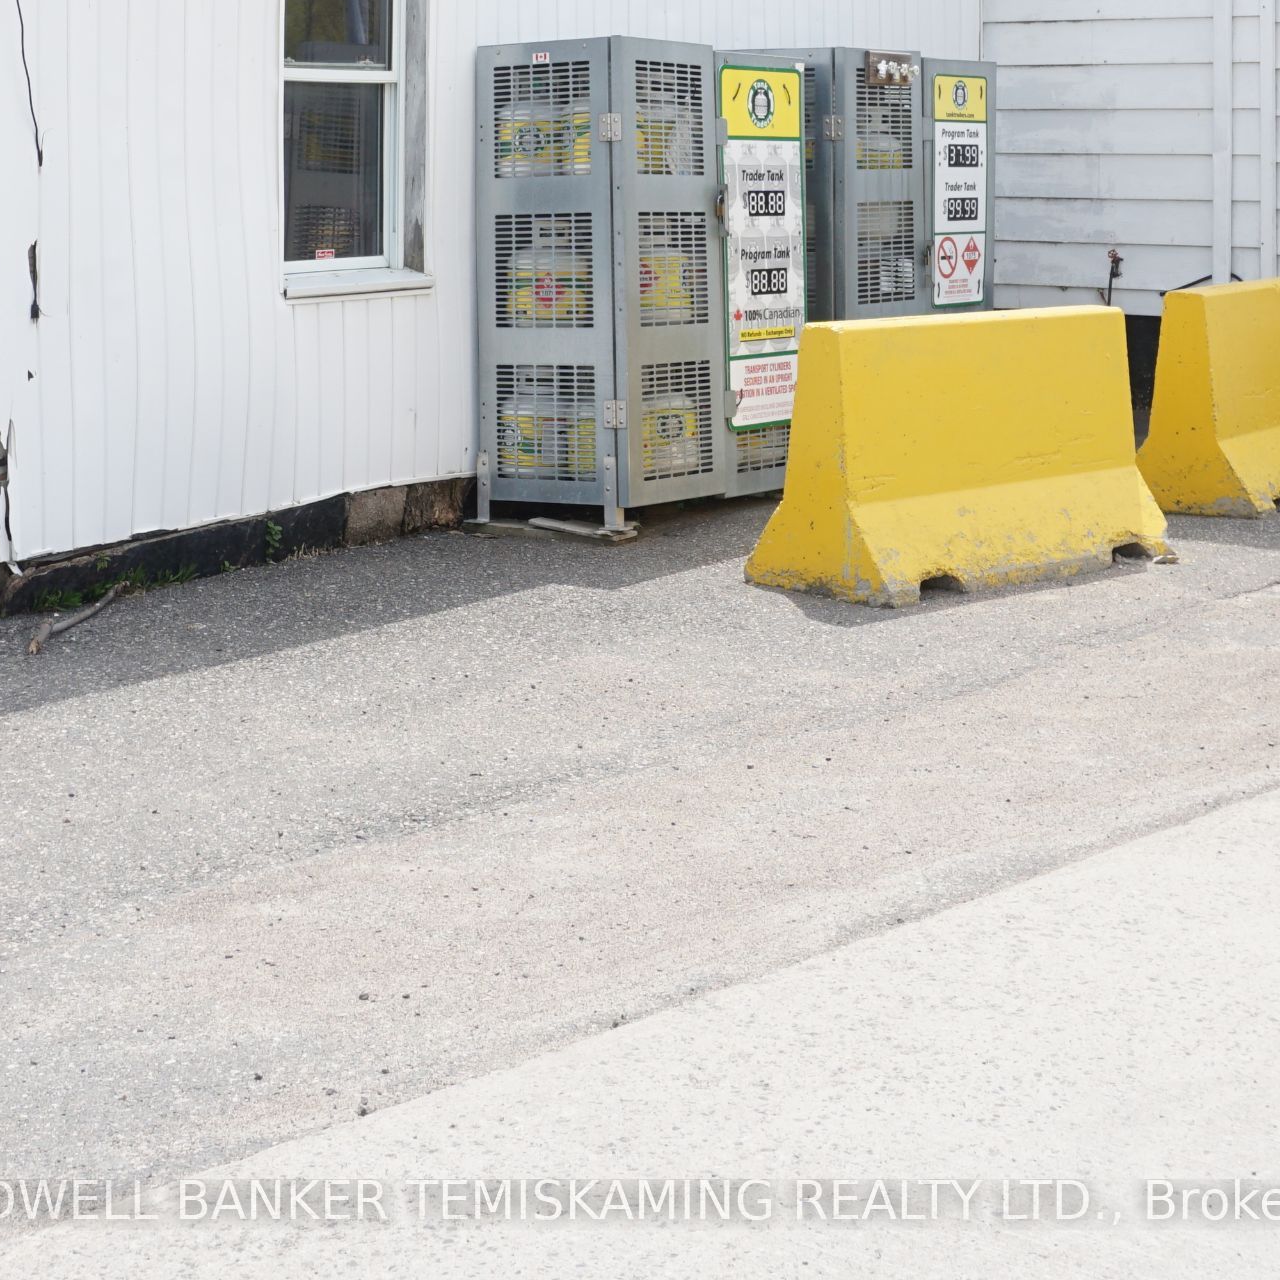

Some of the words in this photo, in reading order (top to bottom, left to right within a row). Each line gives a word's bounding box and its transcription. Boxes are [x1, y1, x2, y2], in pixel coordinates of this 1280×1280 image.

[941, 128, 965, 140] Program
[966, 128, 979, 138] Tank
[742, 169, 765, 181] Trader
[766, 169, 784, 181] Tank
[945, 182, 963, 192] Trader
[964, 182, 976, 192] Tank
[740, 248, 772, 263] Program
[773, 246, 790, 259] Tank
[744, 310, 762, 321] 100%
[763, 307, 800, 320] Canadian
[745, 363, 769, 374] TRANSPORT
[769, 361, 792, 372] CYLINDERS
